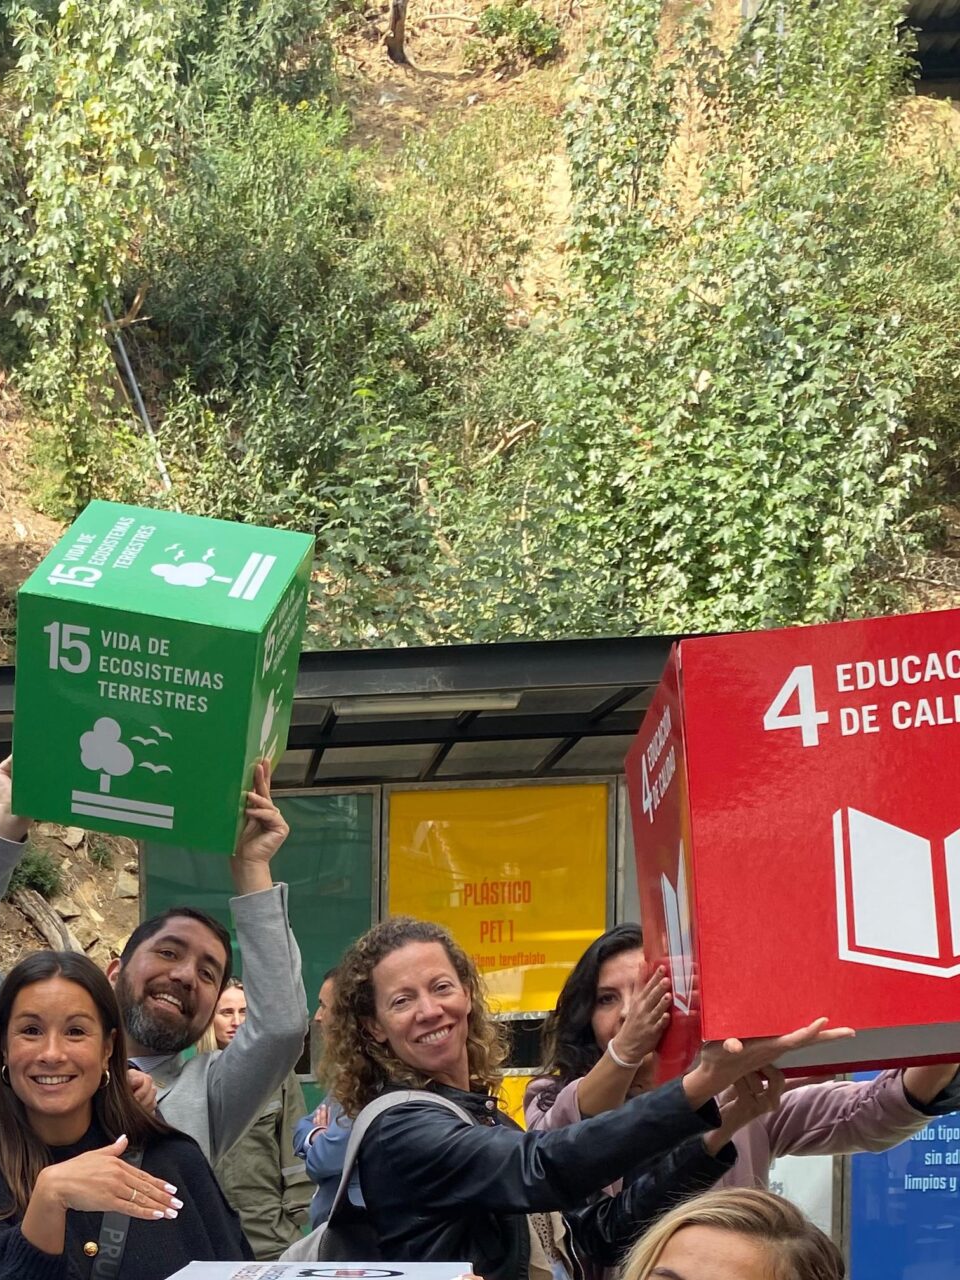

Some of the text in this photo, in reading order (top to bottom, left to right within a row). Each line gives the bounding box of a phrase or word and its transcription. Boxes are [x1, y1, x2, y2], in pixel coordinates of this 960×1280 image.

[62, 533, 97, 561] VIDA DE
[87, 516, 136, 566] ECOSISTEMAS
[112, 524, 157, 569] TERRESTRES
[46, 564, 102, 588] 15
[43, 621, 91, 674] 15
[101, 630, 170, 657] VIDA DE
[99, 656, 224, 691] ECOSISTEMAS
[836, 649, 960, 693] EDUCAC
[98, 680, 209, 713] TERRESTRES
[763, 664, 829, 748] 4
[840, 703, 880, 737] DE
[642, 752, 654, 824] 4
[464, 877, 531, 906] PLÁSTICO
[480, 919, 514, 943] PET 1
[925, 1149, 960, 1165] sin ad
[904, 1174, 957, 1192] limpios y
